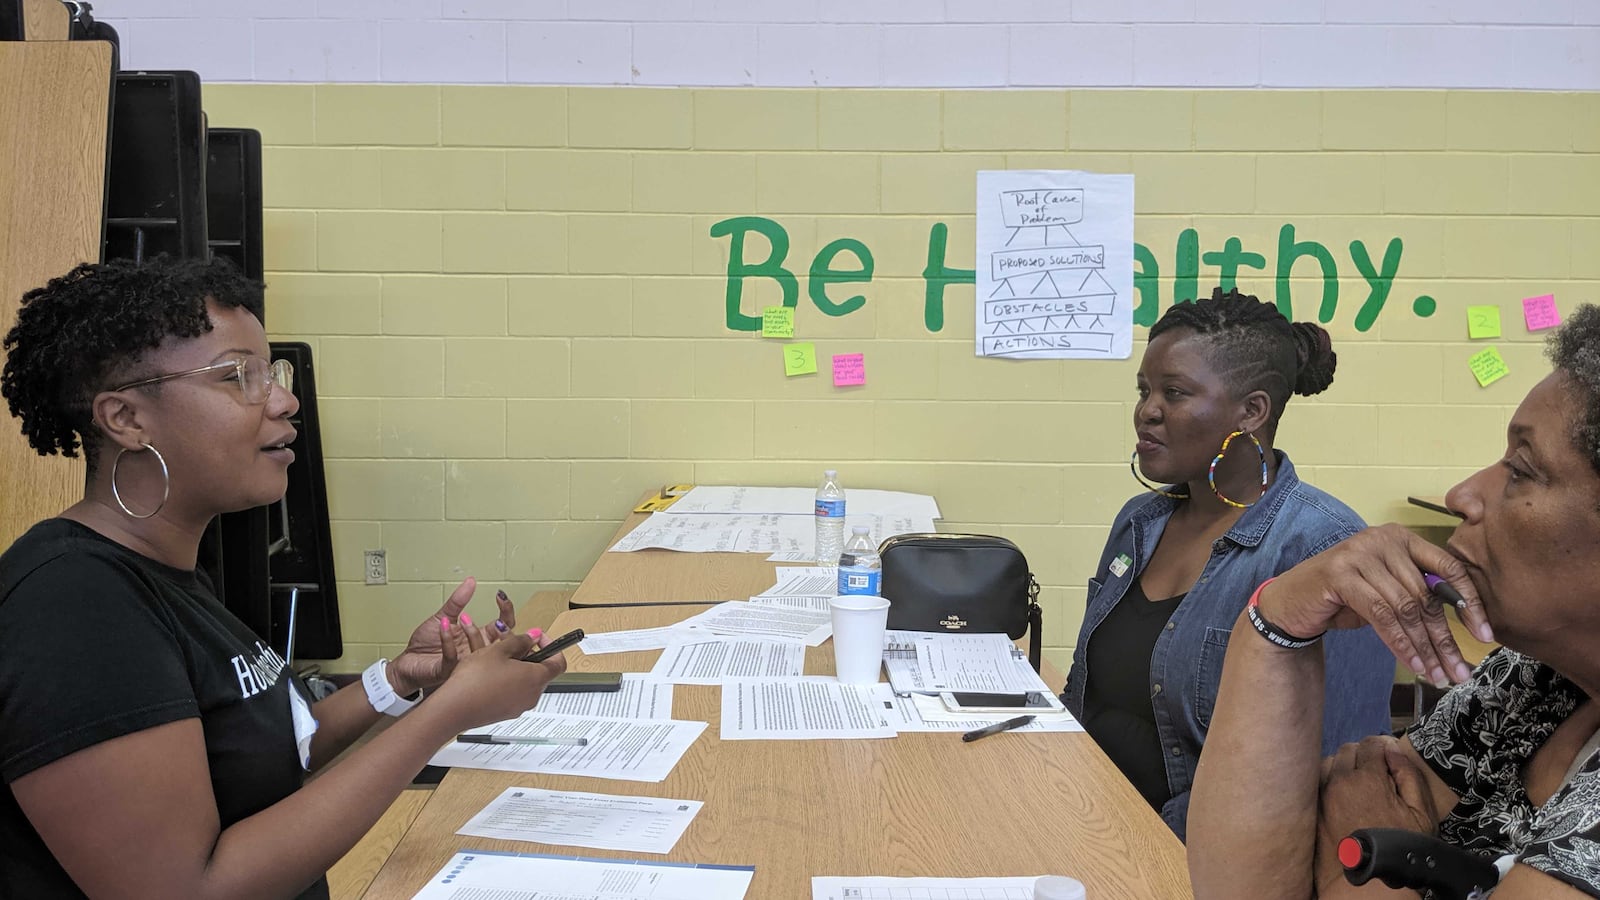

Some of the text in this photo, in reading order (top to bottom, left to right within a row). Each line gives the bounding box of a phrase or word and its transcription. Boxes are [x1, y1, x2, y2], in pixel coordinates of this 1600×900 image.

[1015, 191, 1080, 207] Root Cause
[1021, 214, 1066, 225] Problem
[1000, 250, 1104, 271] PROPOSED SOLUTIONS
[710, 217, 1437, 333] Be Halthy.
[993, 301, 1088, 317] OBSTACLES
[1475, 314, 1494, 329] 2
[993, 335, 1071, 350] ACTIONS
[791, 349, 806, 369] 3
[1254, 617, 1265, 631] Us
